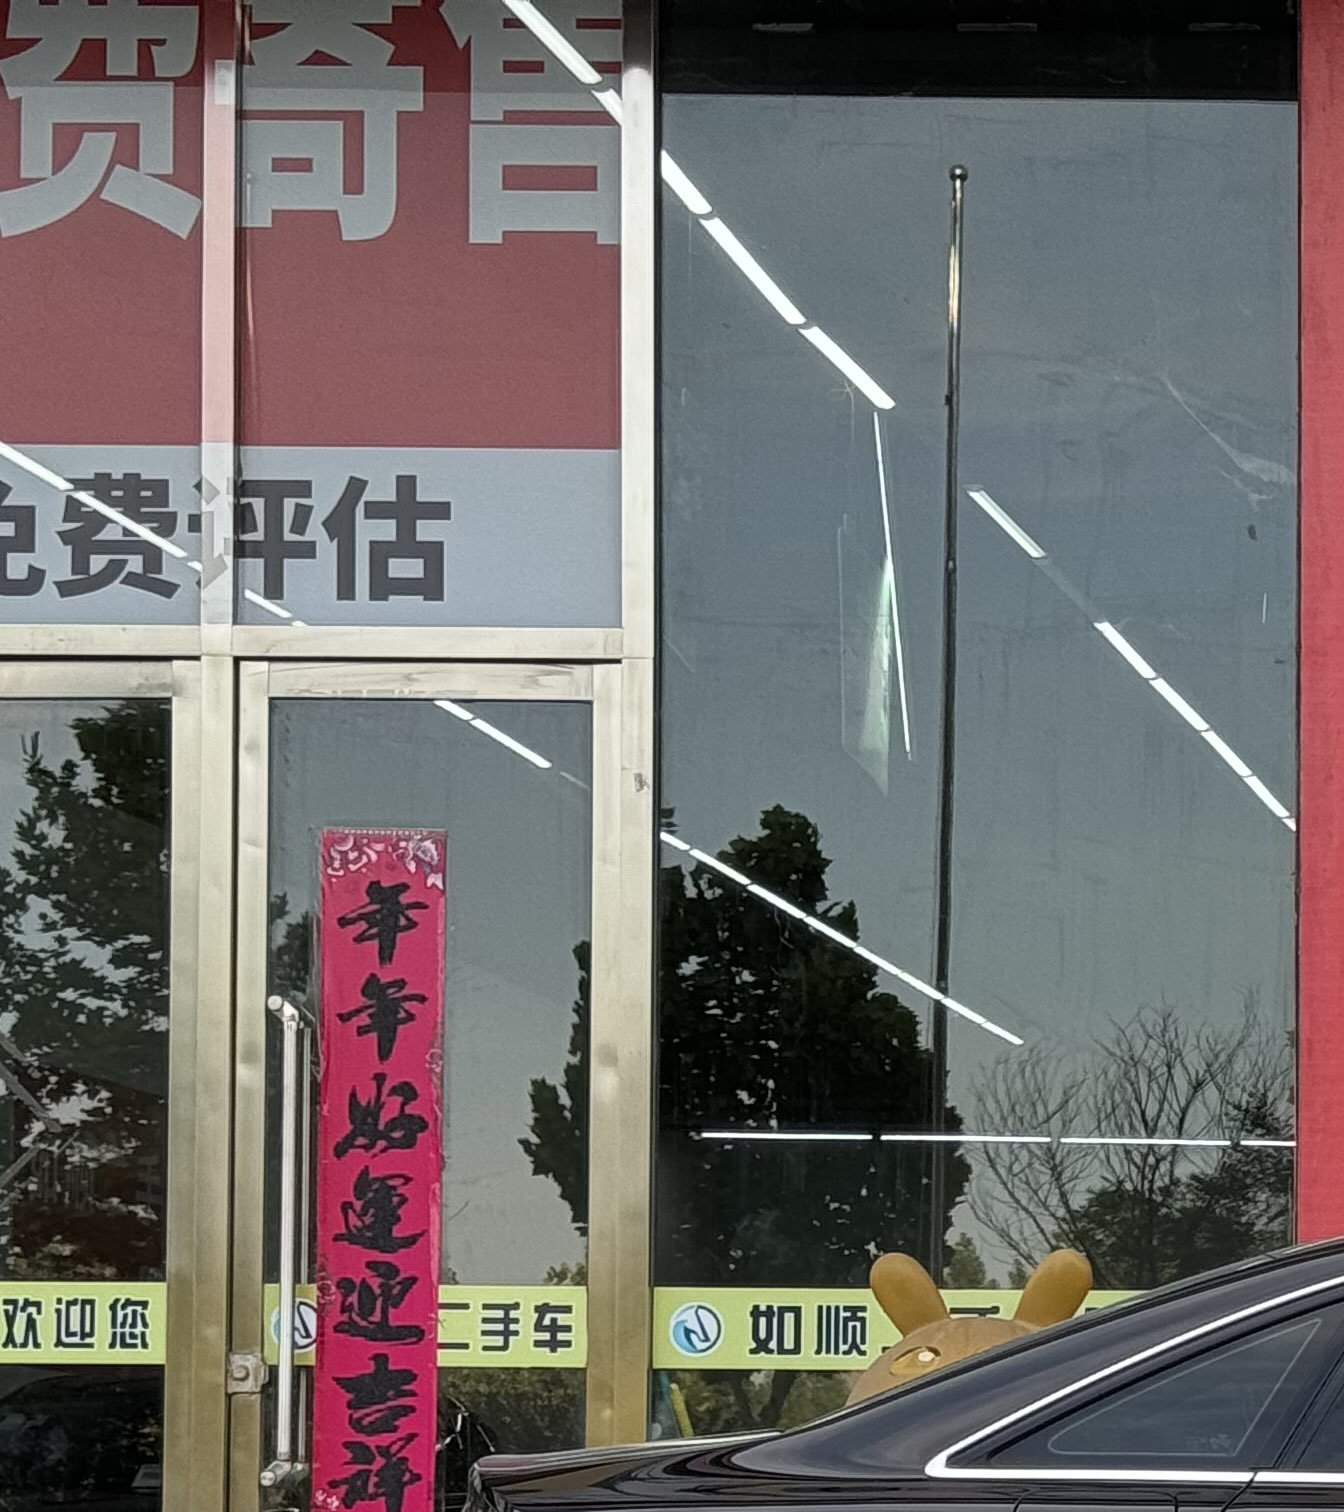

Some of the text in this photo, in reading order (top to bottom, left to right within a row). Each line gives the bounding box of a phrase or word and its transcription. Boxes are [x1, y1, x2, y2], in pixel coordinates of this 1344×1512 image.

[1, 1297, 150, 1350] 欢迎您
[437, 1301, 574, 1354] 二手车
